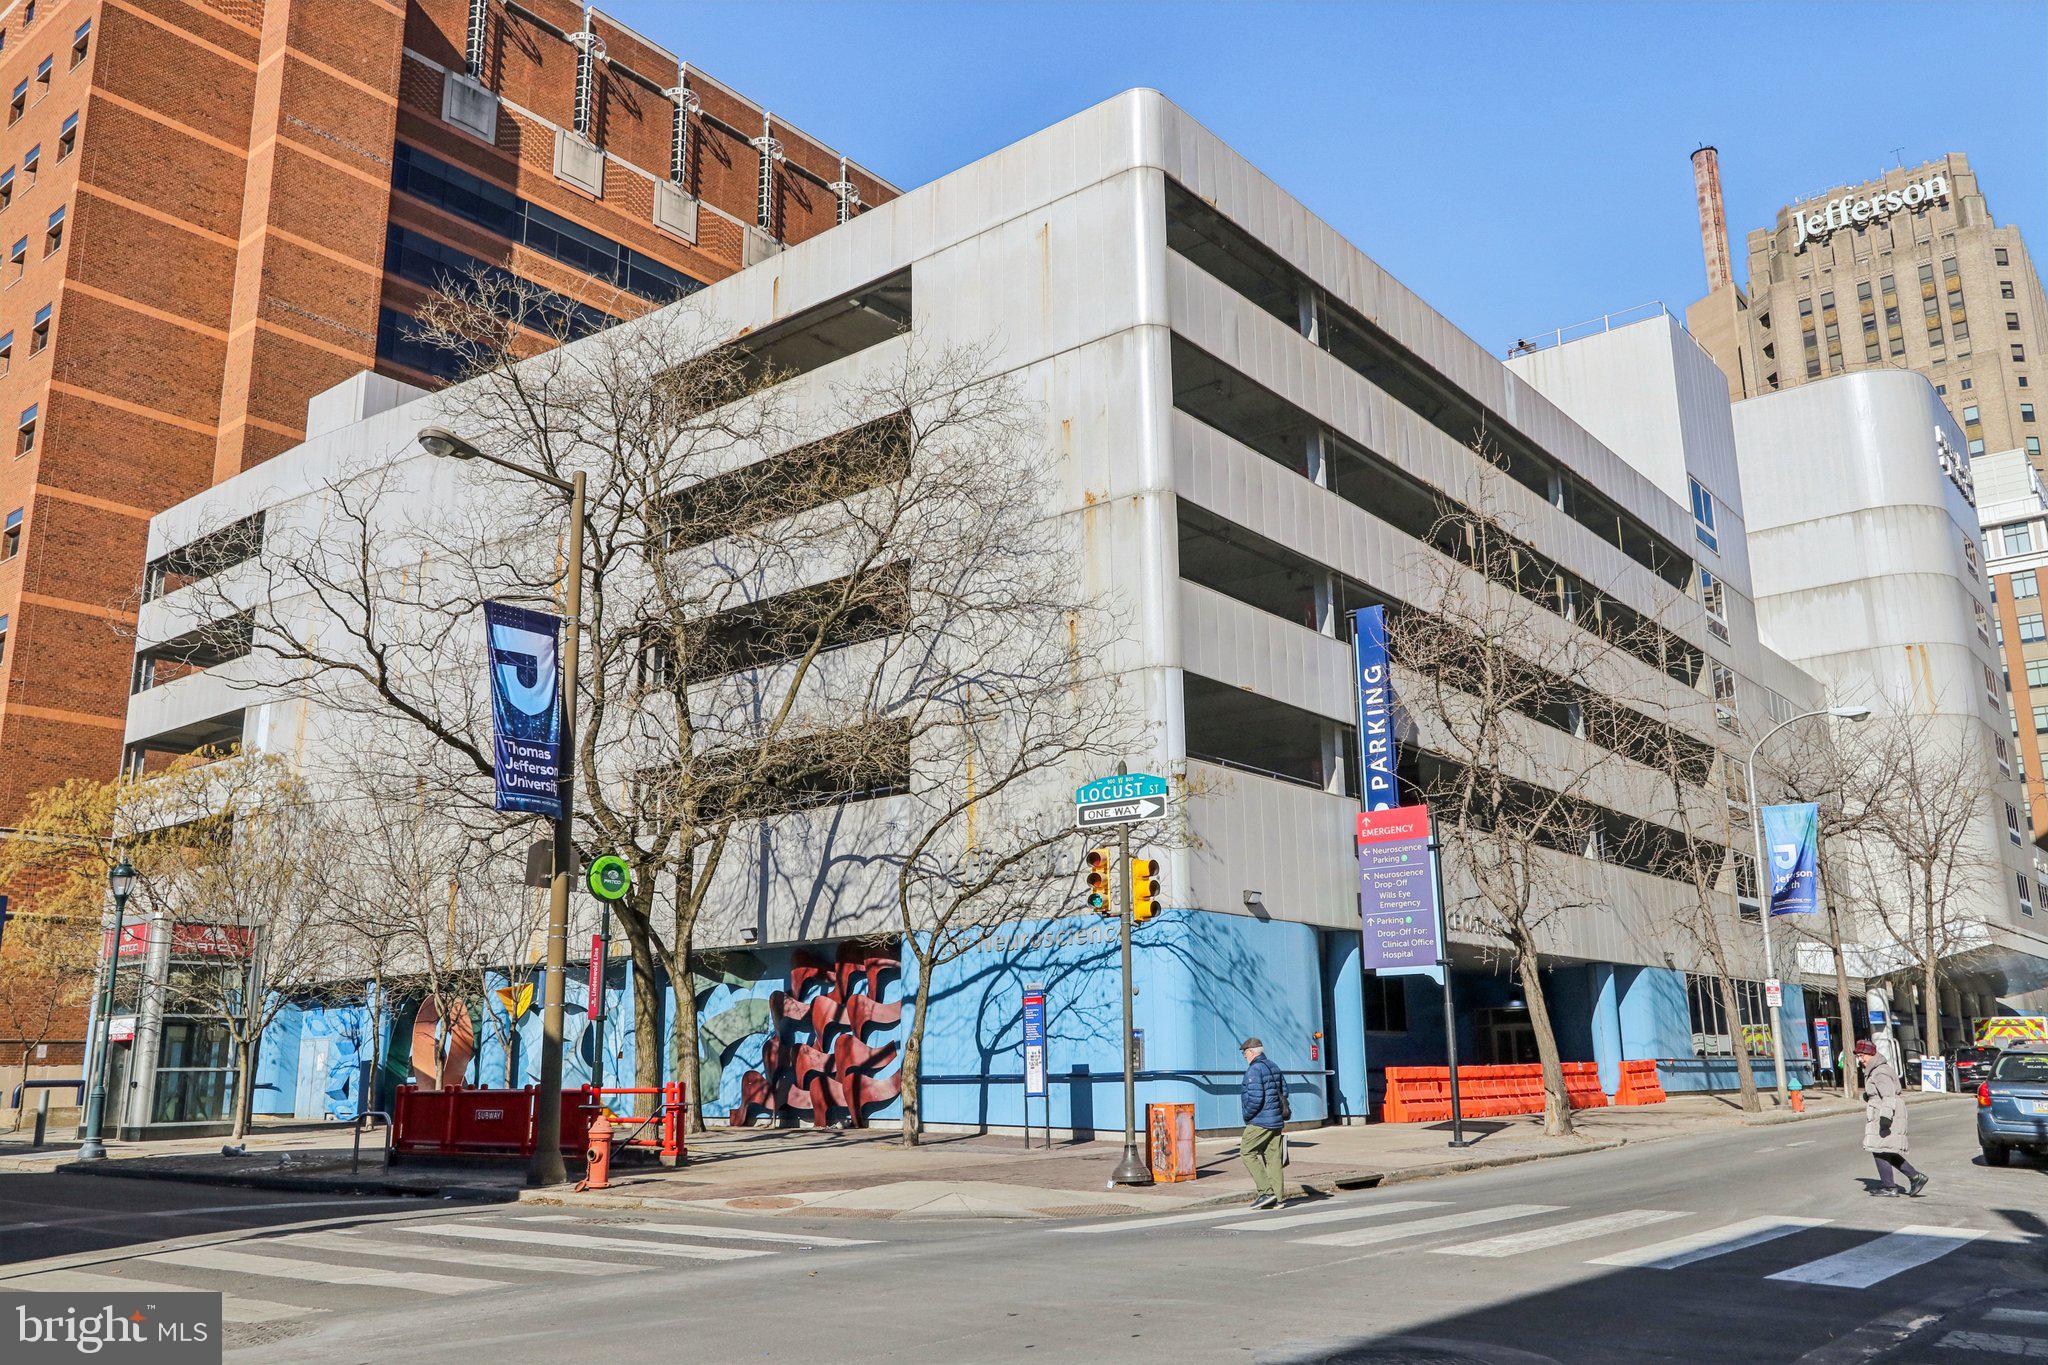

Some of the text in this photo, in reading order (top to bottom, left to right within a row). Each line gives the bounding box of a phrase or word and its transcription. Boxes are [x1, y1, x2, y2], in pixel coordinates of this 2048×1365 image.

[1792, 176, 1950, 247] Jefferson
[1364, 664, 1389, 791] PARKING
[504, 740, 551, 760] Thomas
[505, 756, 558, 777] Jefferson
[1080, 782, 1159, 803] LOCUST ST
[1088, 805, 1140, 820] ONE WAY
[1361, 823, 1414, 838] EMERGENCY
[1372, 844, 1422, 855] Neuroscience
[1373, 855, 1400, 864] Parking
[1373, 869, 1424, 880] Neuroscience
[1776, 869, 1813, 884] Jefson
[1374, 879, 1408, 889] Drop-Off
[1379, 890, 1411, 899] Wills Eye
[1380, 900, 1421, 909] Emergency
[1377, 917, 1404, 926] Parking
[1377, 927, 1428, 938] Drop-Off For:
[977, 924, 1122, 955] Neuroscienc
[1382, 939, 1434, 948] Clinical Office
[1382, 950, 1414, 959] Hospital
[591, 961, 599, 997] Lindenwold
[477, 1111, 501, 1120] SUBWAY
